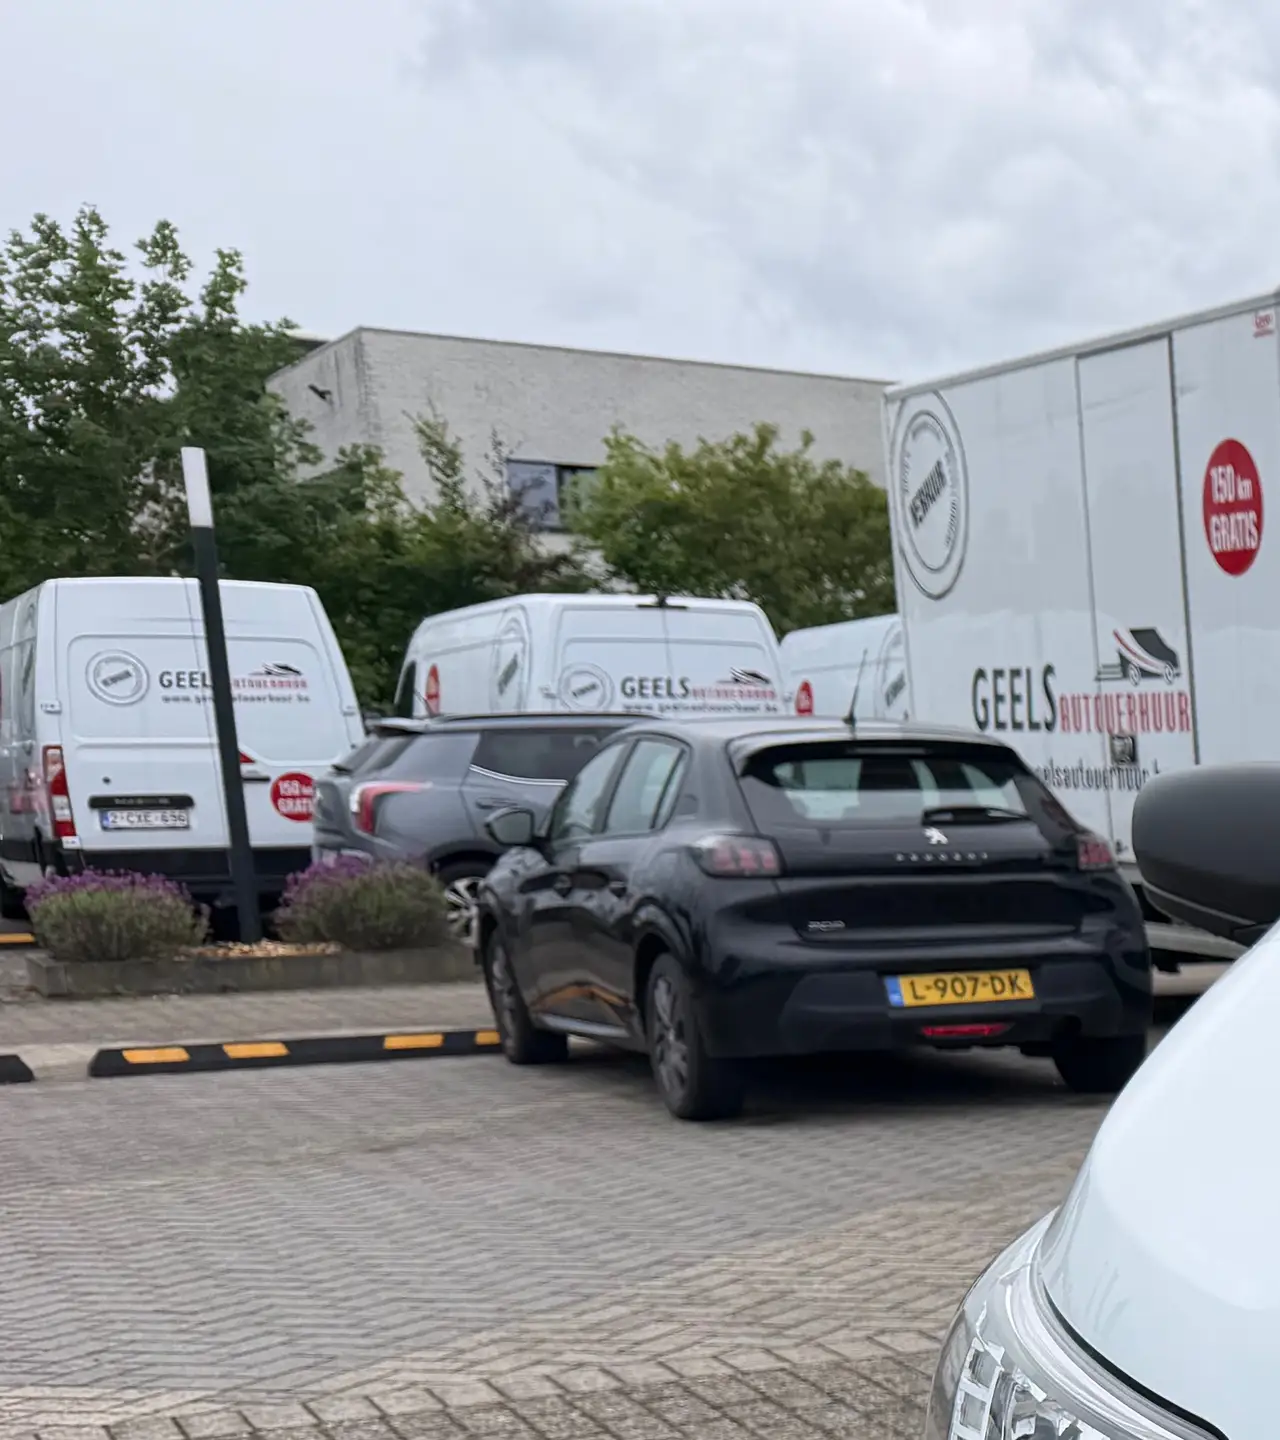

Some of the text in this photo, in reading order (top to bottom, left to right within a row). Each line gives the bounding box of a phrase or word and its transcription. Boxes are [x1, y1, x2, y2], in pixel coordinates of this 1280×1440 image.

[1211, 464, 1253, 503] 150 km
[1210, 511, 1259, 552] GRATIS
[620, 676, 690, 699] GEELS
[971, 663, 1057, 732] GEELS
[909, 973, 1026, 1000] L-907-DK
